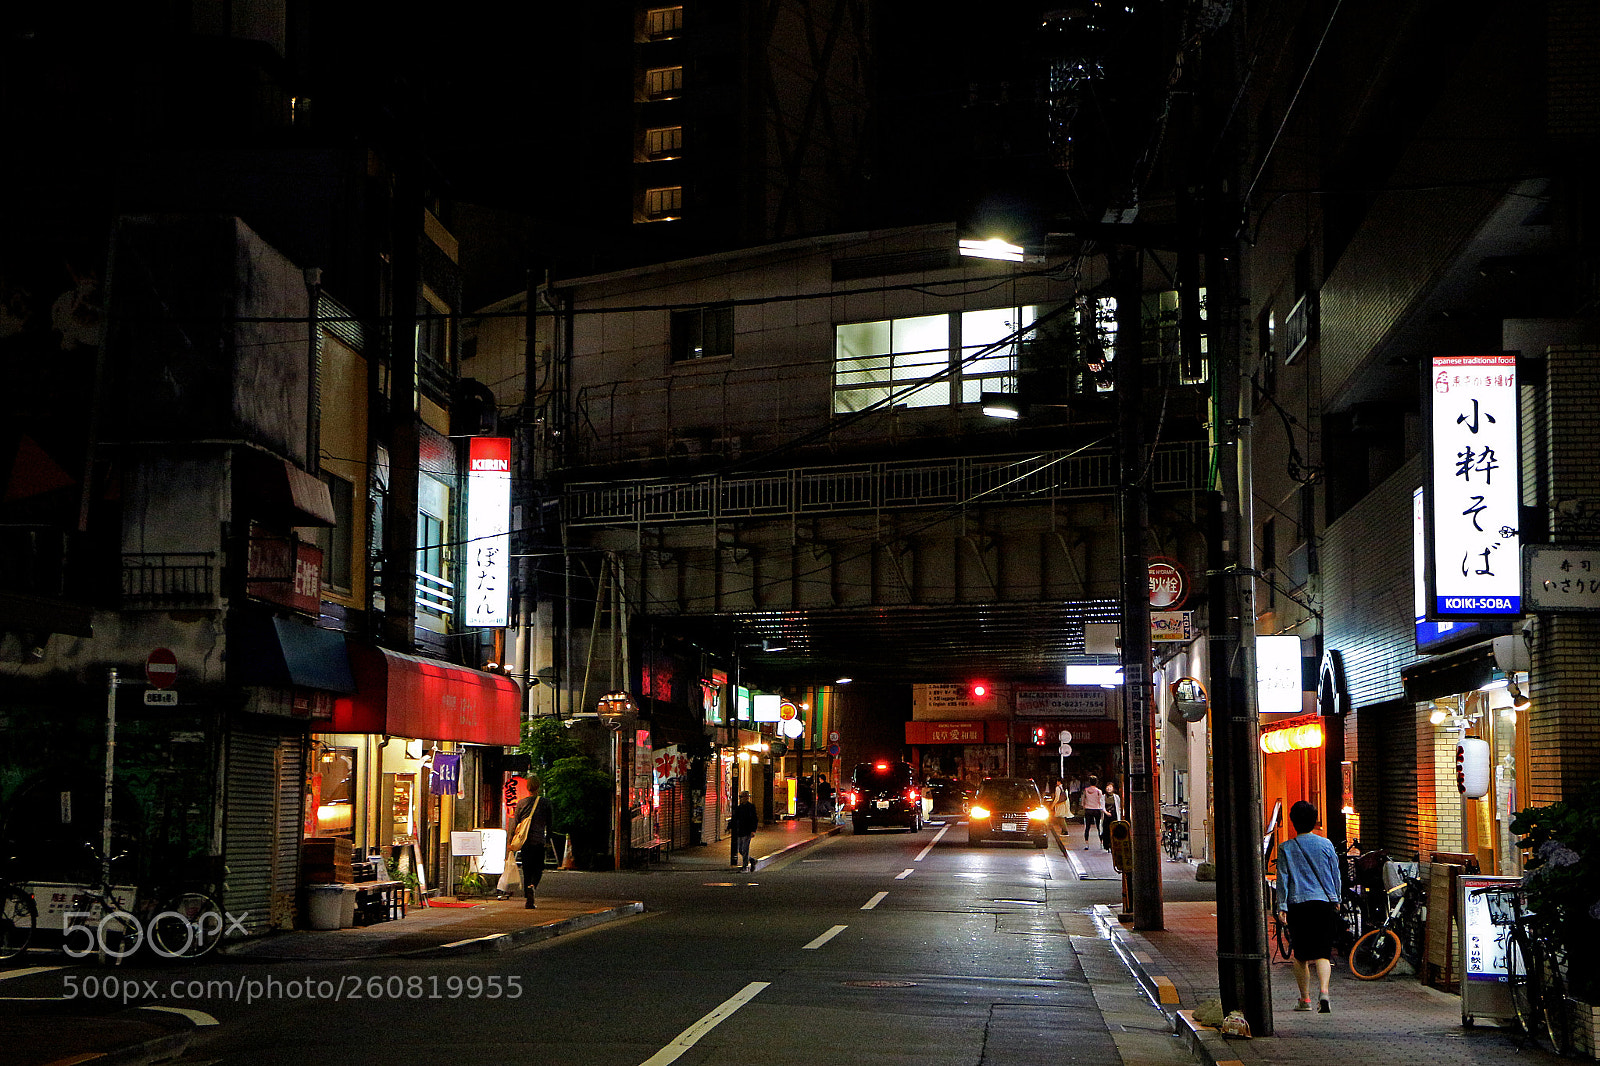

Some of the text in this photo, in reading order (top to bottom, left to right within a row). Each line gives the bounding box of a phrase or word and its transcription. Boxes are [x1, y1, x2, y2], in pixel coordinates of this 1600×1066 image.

[472, 459, 508, 470] KIRIN
[1456, 398, 1500, 577] 小粋そば
[1560, 559, 1591, 572] 寿司
[477, 547, 499, 614] ぼたん
[1445, 597, 1512, 610] KOIKI-SOBA
[932, 729, 978, 741] 浅草愛和服
[1470, 936, 1482, 971] ちょい飲み
